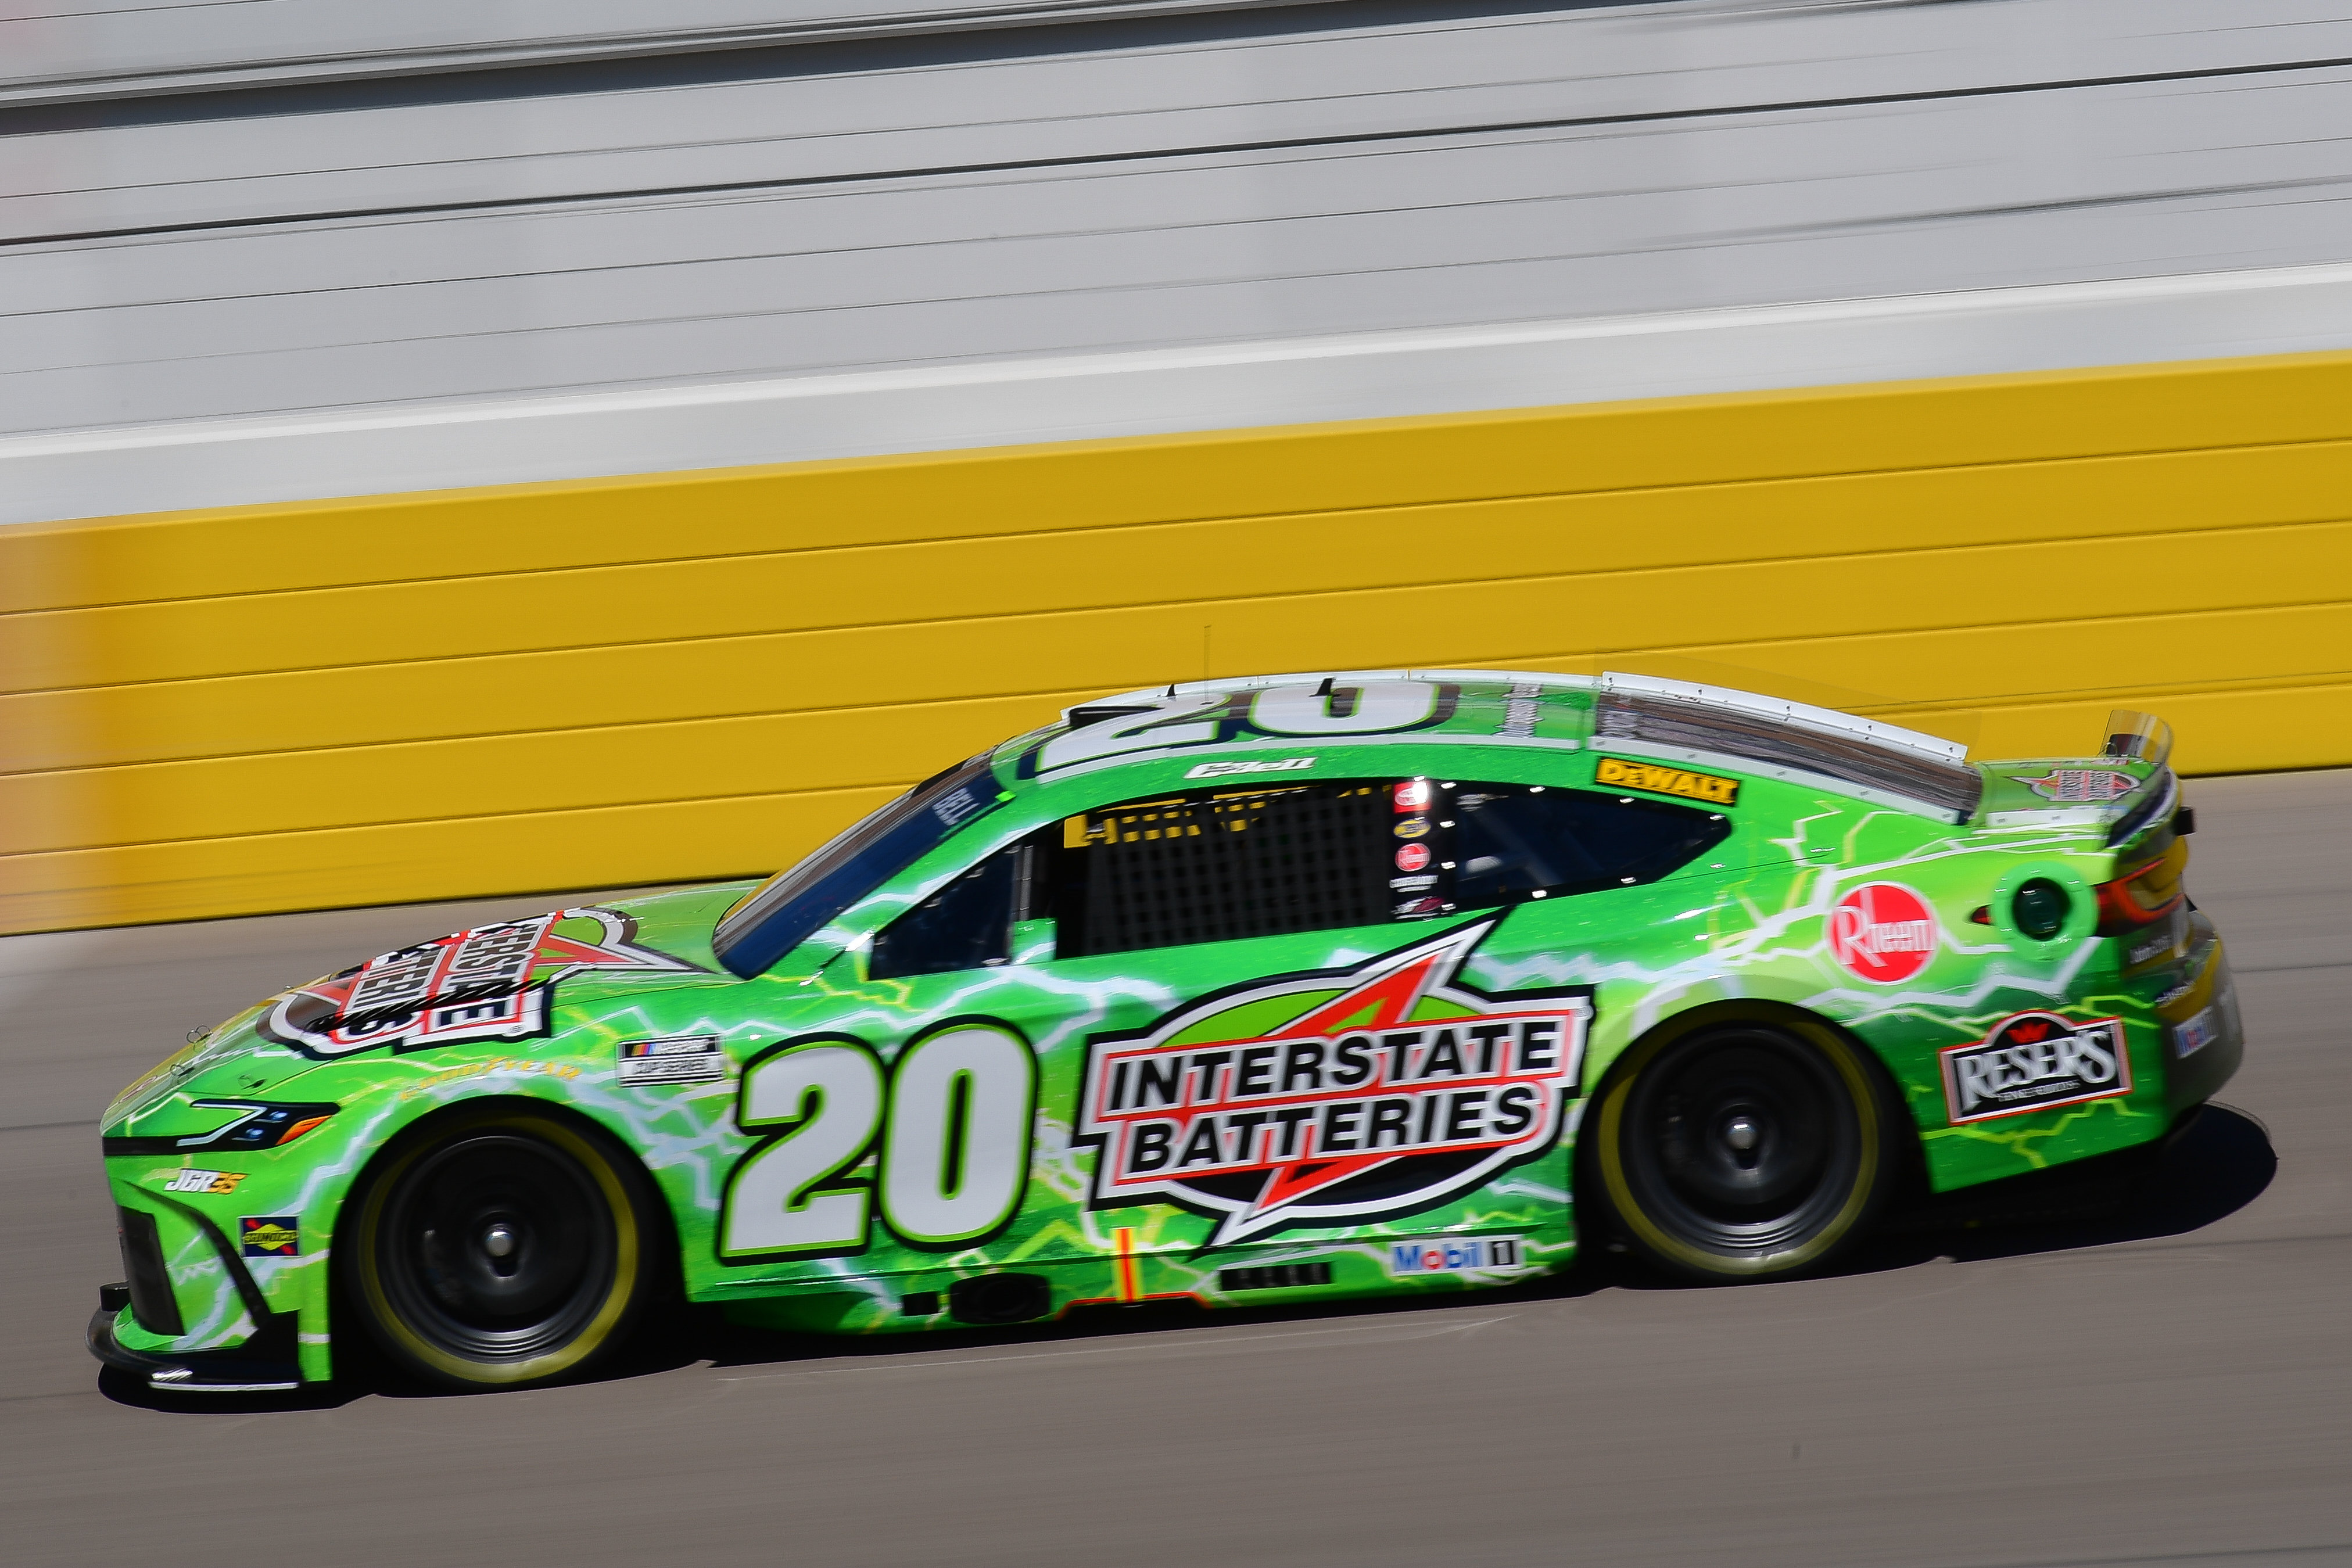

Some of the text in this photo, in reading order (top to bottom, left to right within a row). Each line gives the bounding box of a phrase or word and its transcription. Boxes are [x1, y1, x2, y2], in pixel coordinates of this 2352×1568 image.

[1110, 1020, 1560, 1111] INTERSTATE
[719, 1018, 1037, 1261] 20
[1130, 1086, 1537, 1174] BATTERIES
[1393, 1241, 1483, 1272] Mobil
